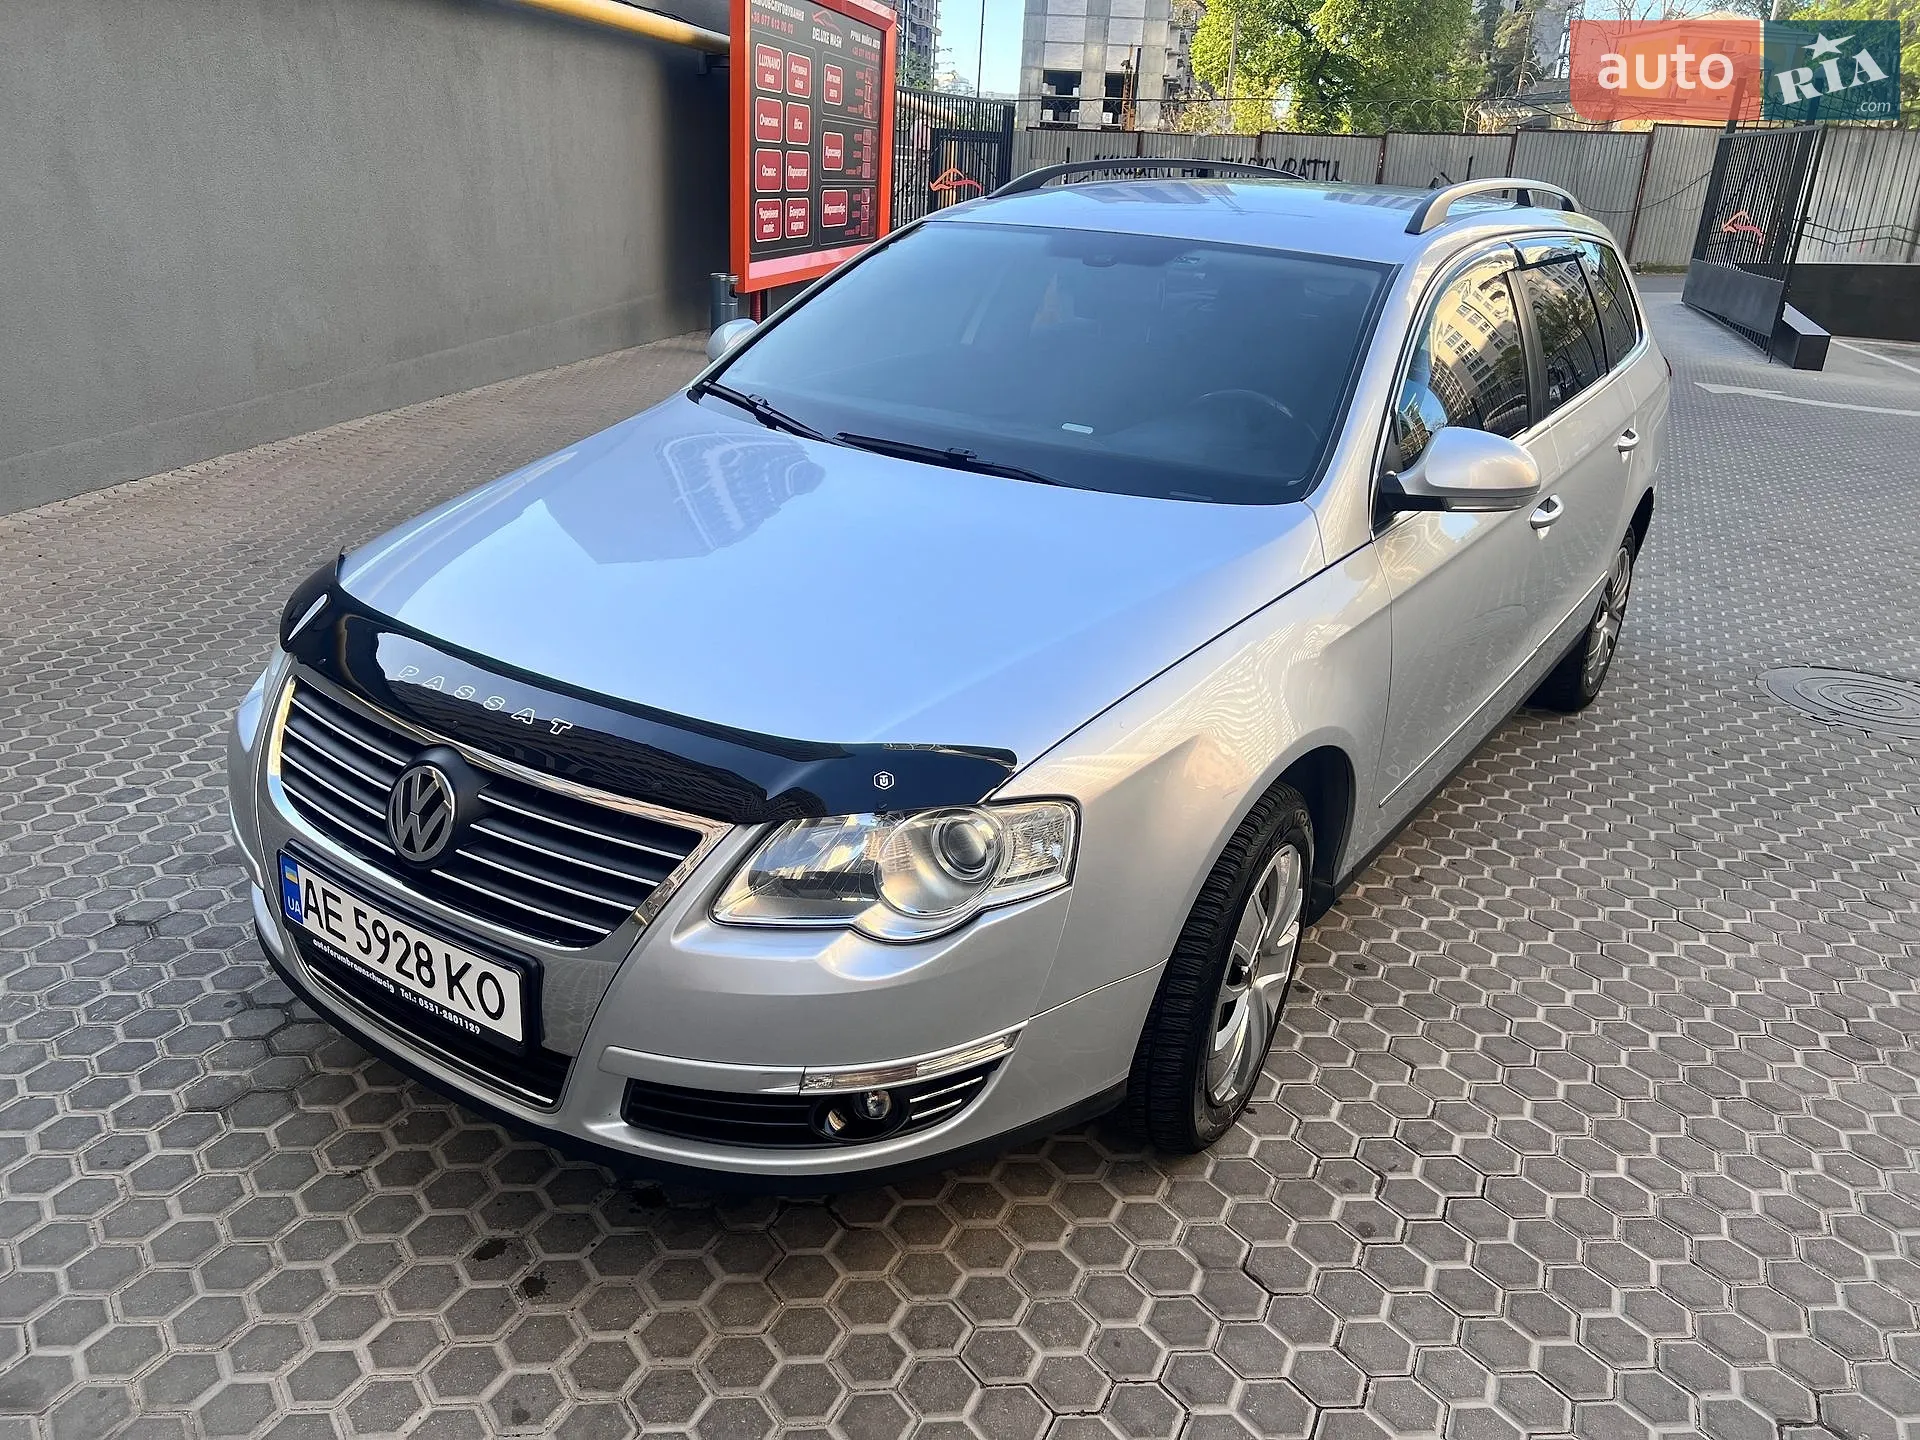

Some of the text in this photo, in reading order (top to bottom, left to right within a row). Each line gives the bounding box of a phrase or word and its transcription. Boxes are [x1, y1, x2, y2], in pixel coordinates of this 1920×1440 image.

[398, 665, 573, 734] PASSAT
[288, 896, 302, 915] UA
[304, 878, 506, 1020] AE 5928 KO
